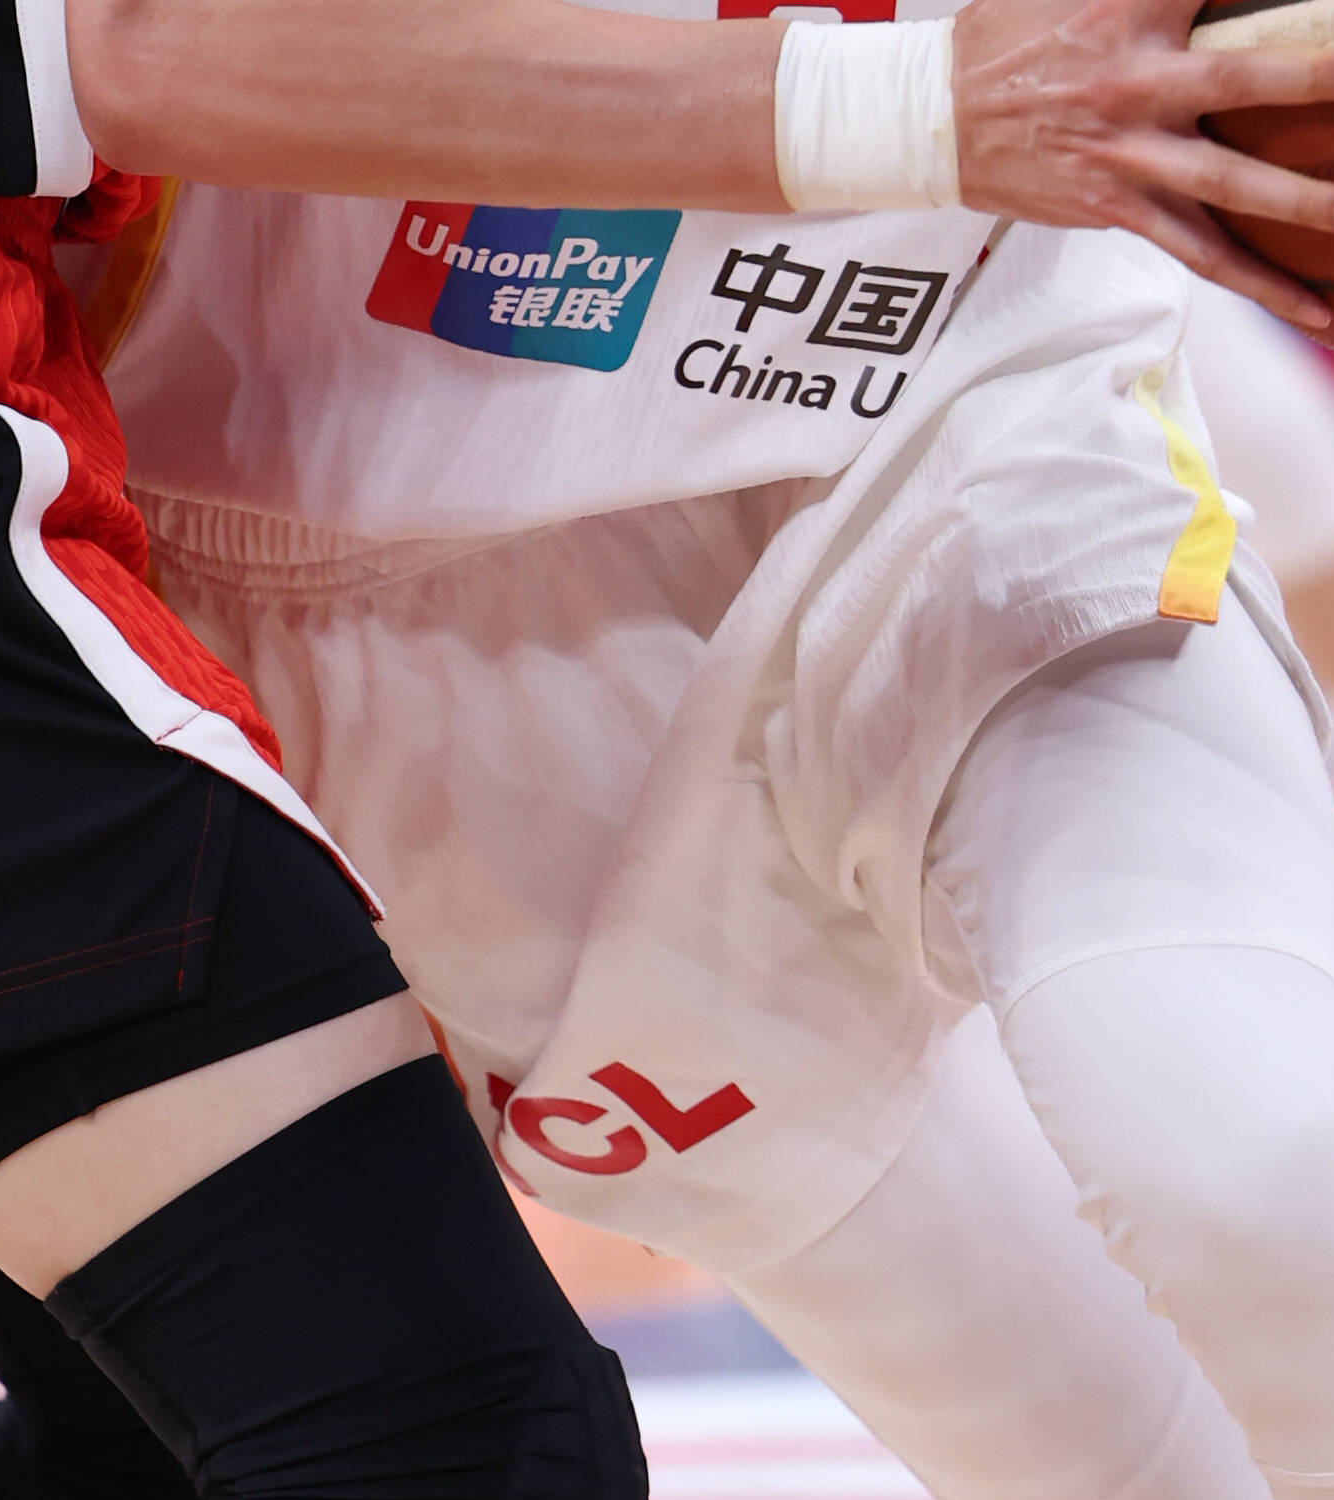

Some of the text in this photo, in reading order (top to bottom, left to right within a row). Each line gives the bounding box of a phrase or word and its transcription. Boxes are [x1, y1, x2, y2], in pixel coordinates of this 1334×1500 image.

[405, 214, 654, 300] UnionPay
[489, 285, 622, 334] 银联
[711, 243, 949, 356] 中国
[674, 339, 837, 411] China
